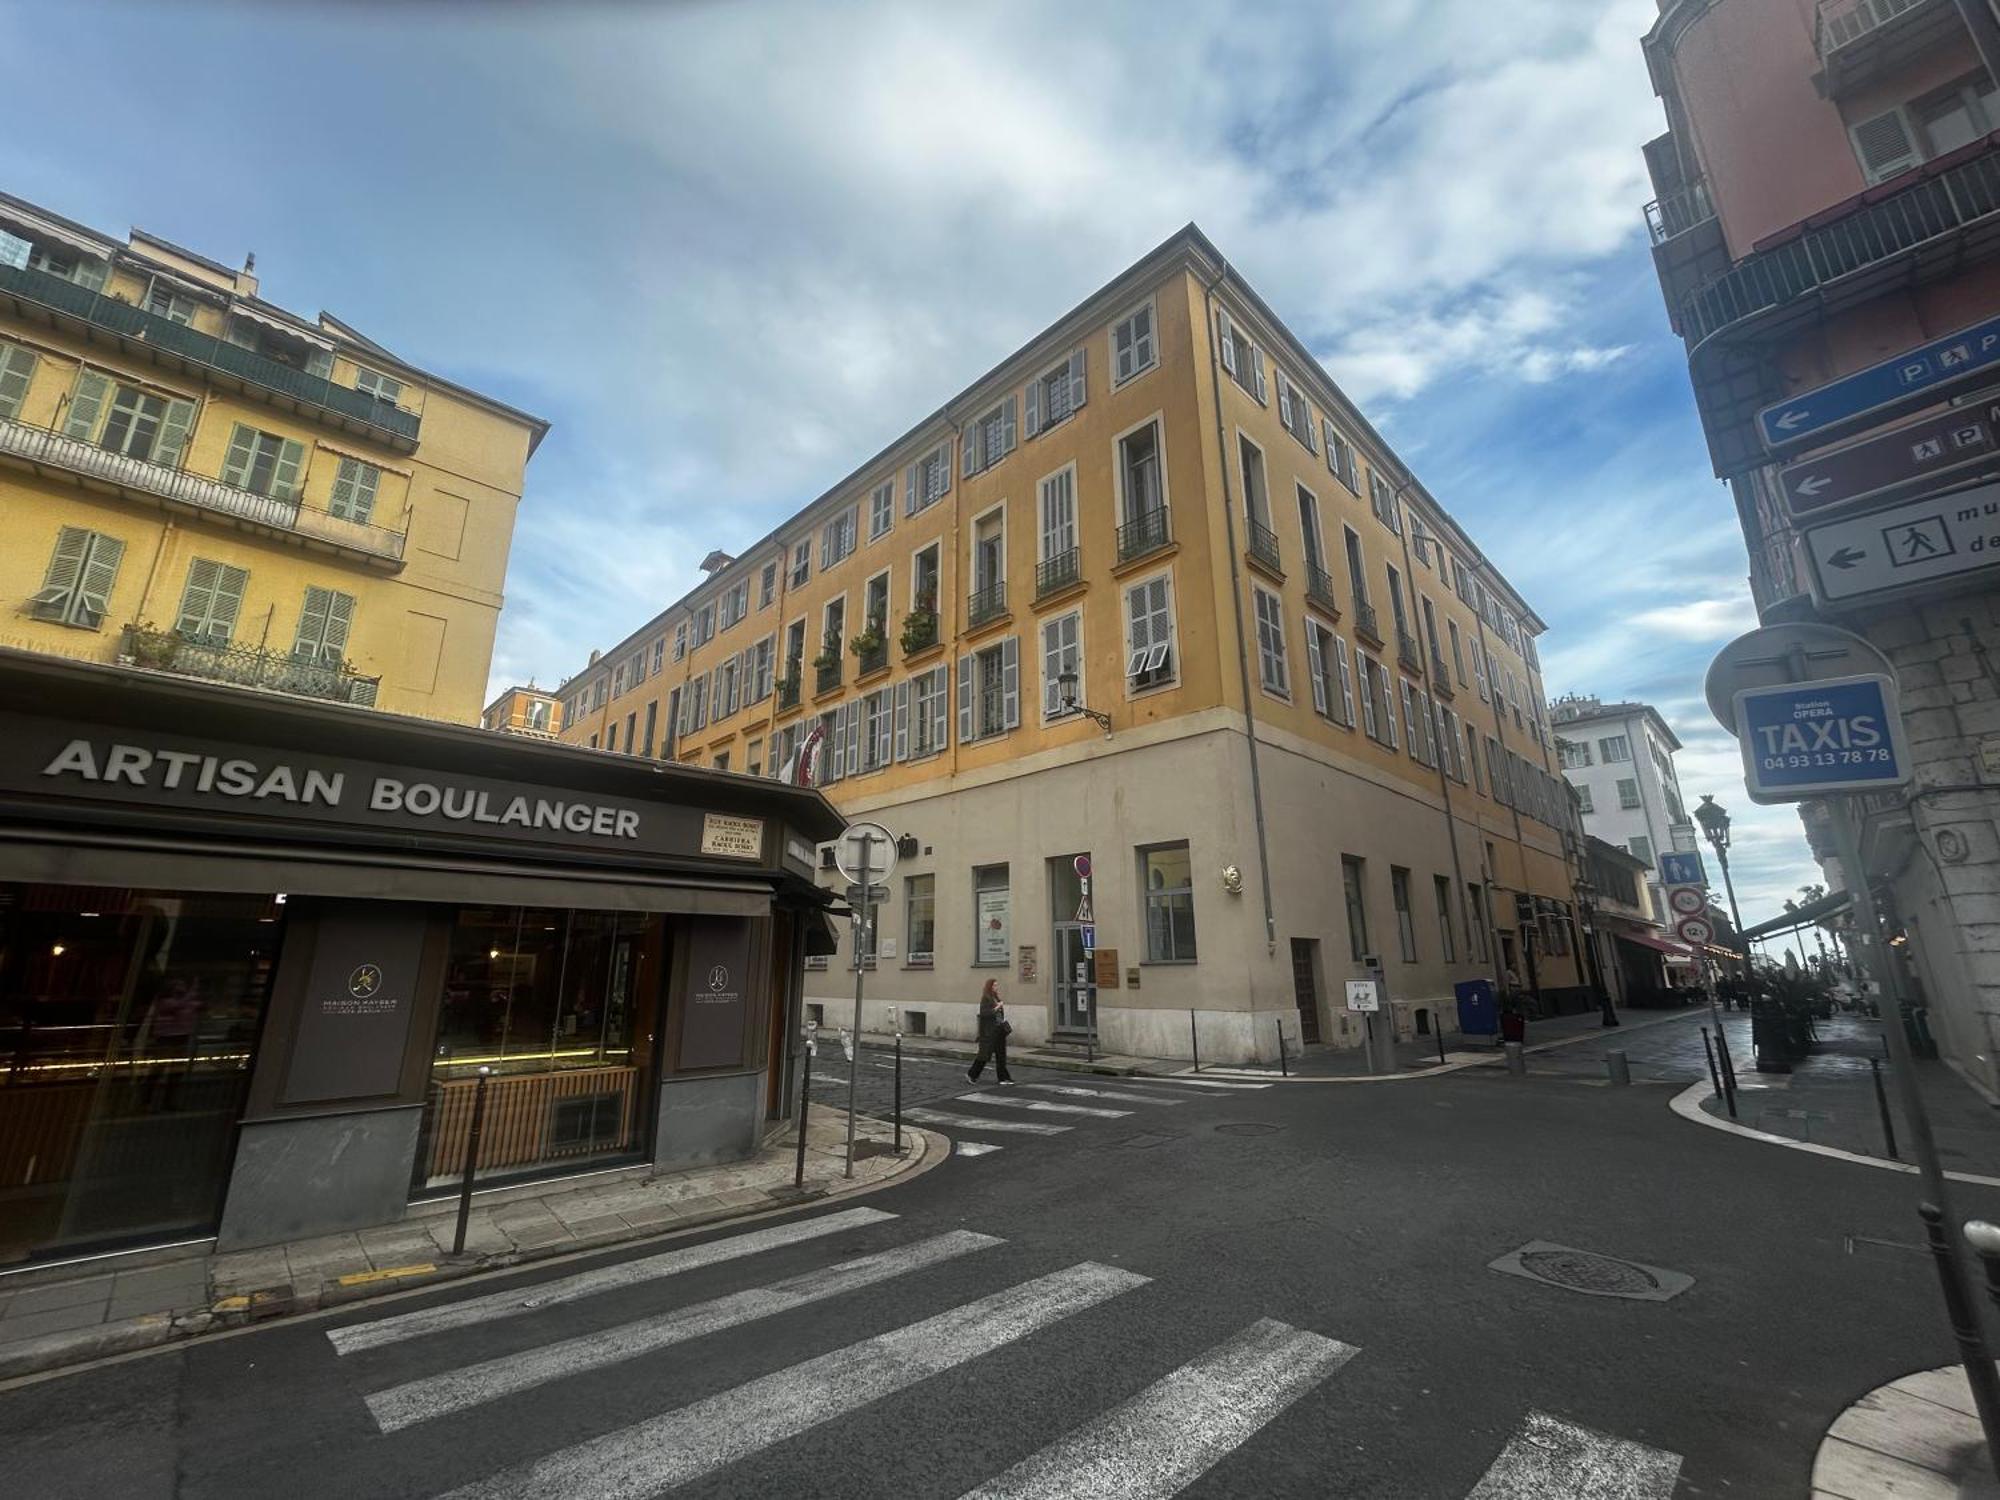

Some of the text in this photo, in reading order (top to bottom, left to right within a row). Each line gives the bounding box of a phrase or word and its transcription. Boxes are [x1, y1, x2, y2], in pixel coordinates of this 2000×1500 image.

[1793, 707, 1834, 719] OPERA
[1794, 700, 1830, 710] Station
[1757, 715, 1881, 755] TAXIS
[1764, 748, 1889, 769] 04 93 13 78 78
[43, 739, 641, 839] ARTISAN BOULANGER
